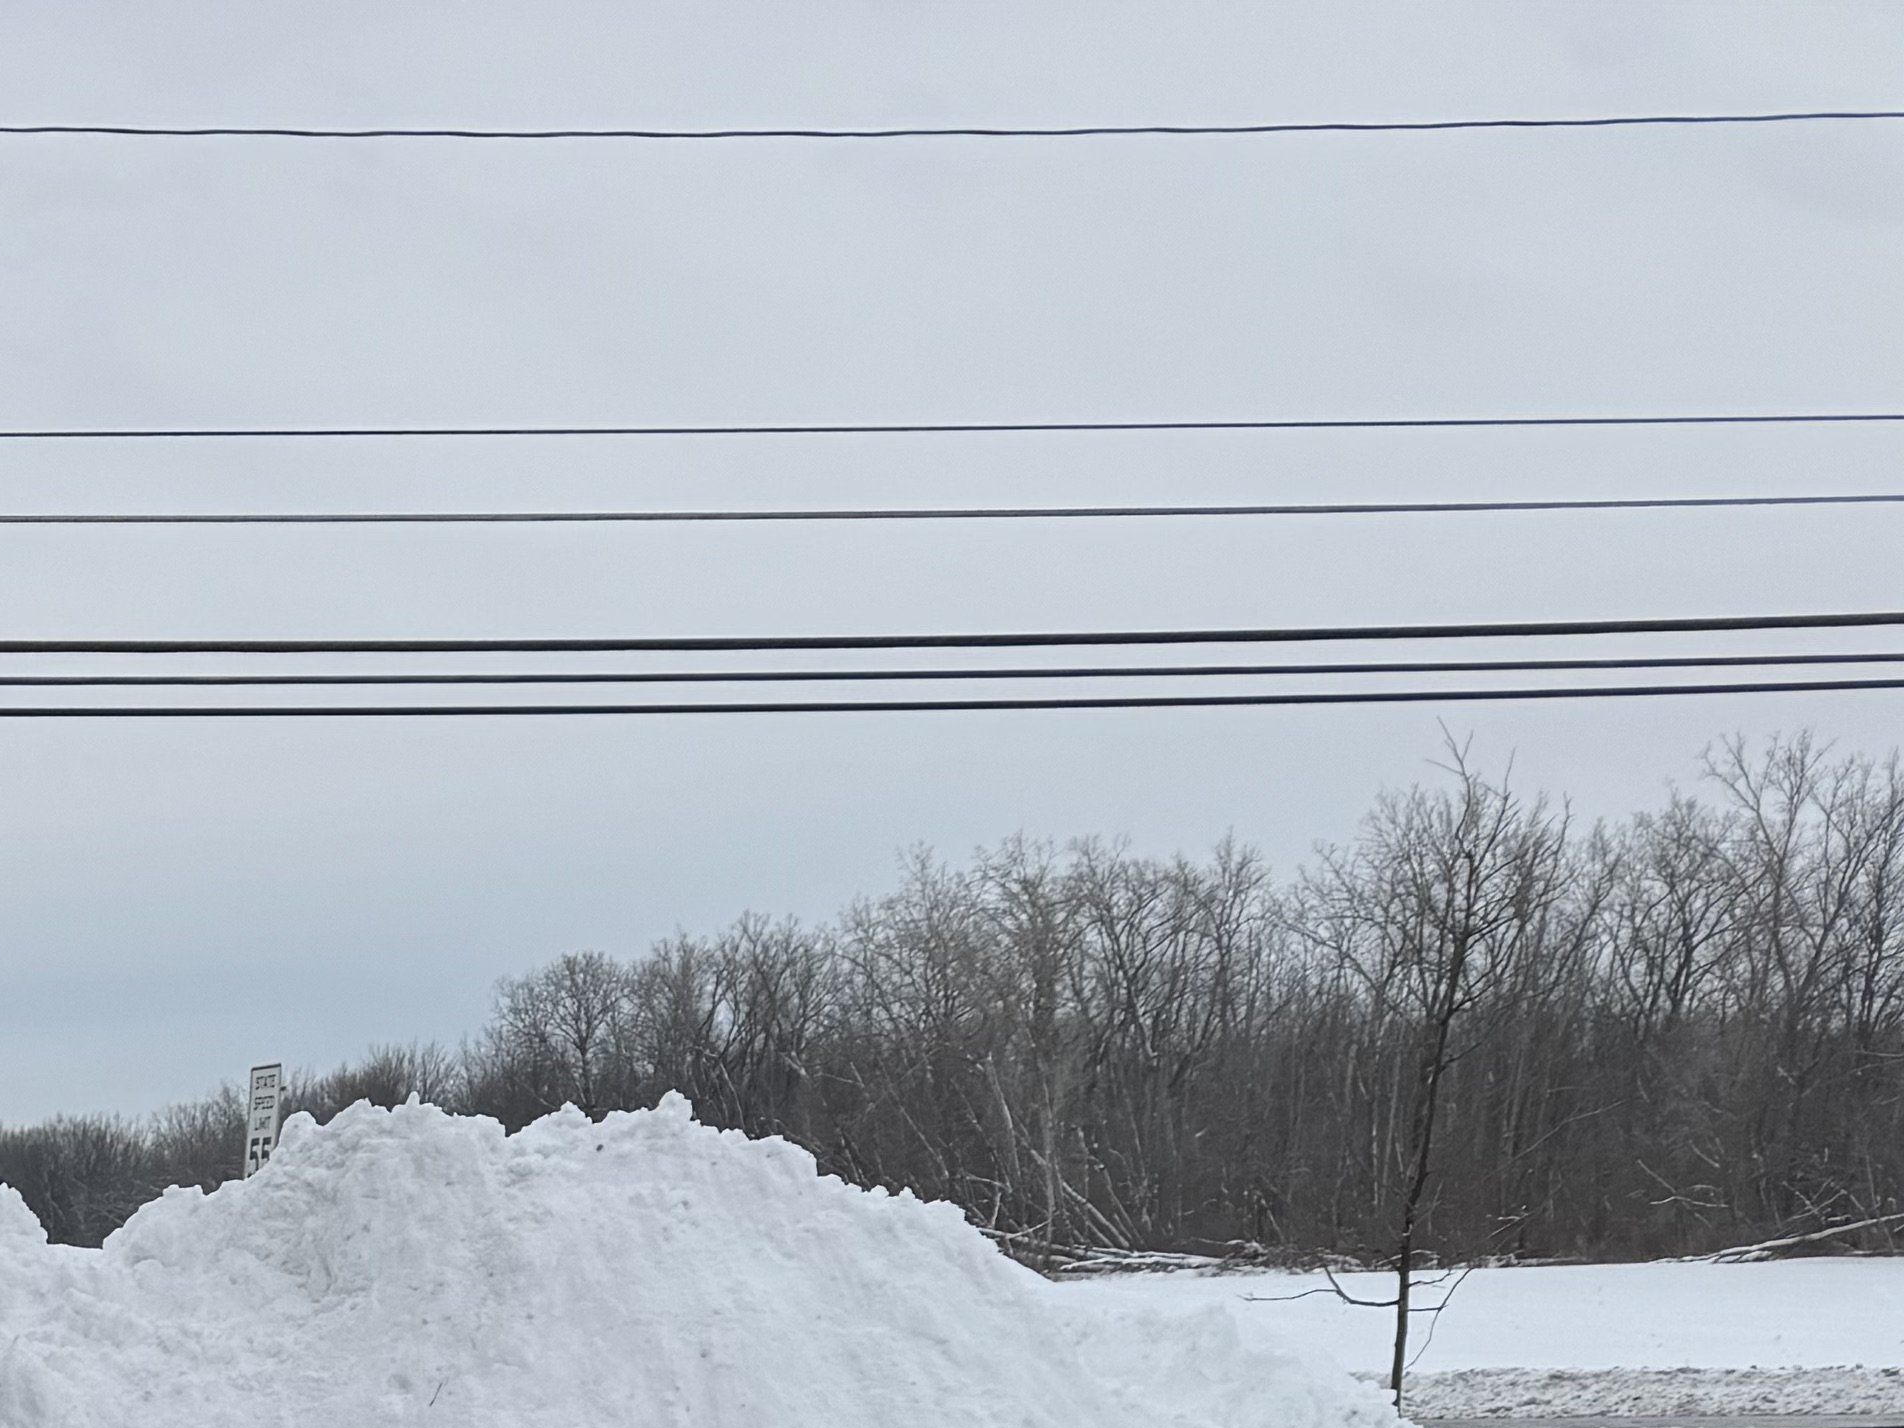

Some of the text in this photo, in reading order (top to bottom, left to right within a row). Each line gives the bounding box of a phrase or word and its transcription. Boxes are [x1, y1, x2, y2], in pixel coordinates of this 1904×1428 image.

[255, 1074, 276, 1090] STATE
[253, 1095, 275, 1111] SPEED
[253, 1116, 272, 1131] LIMIT
